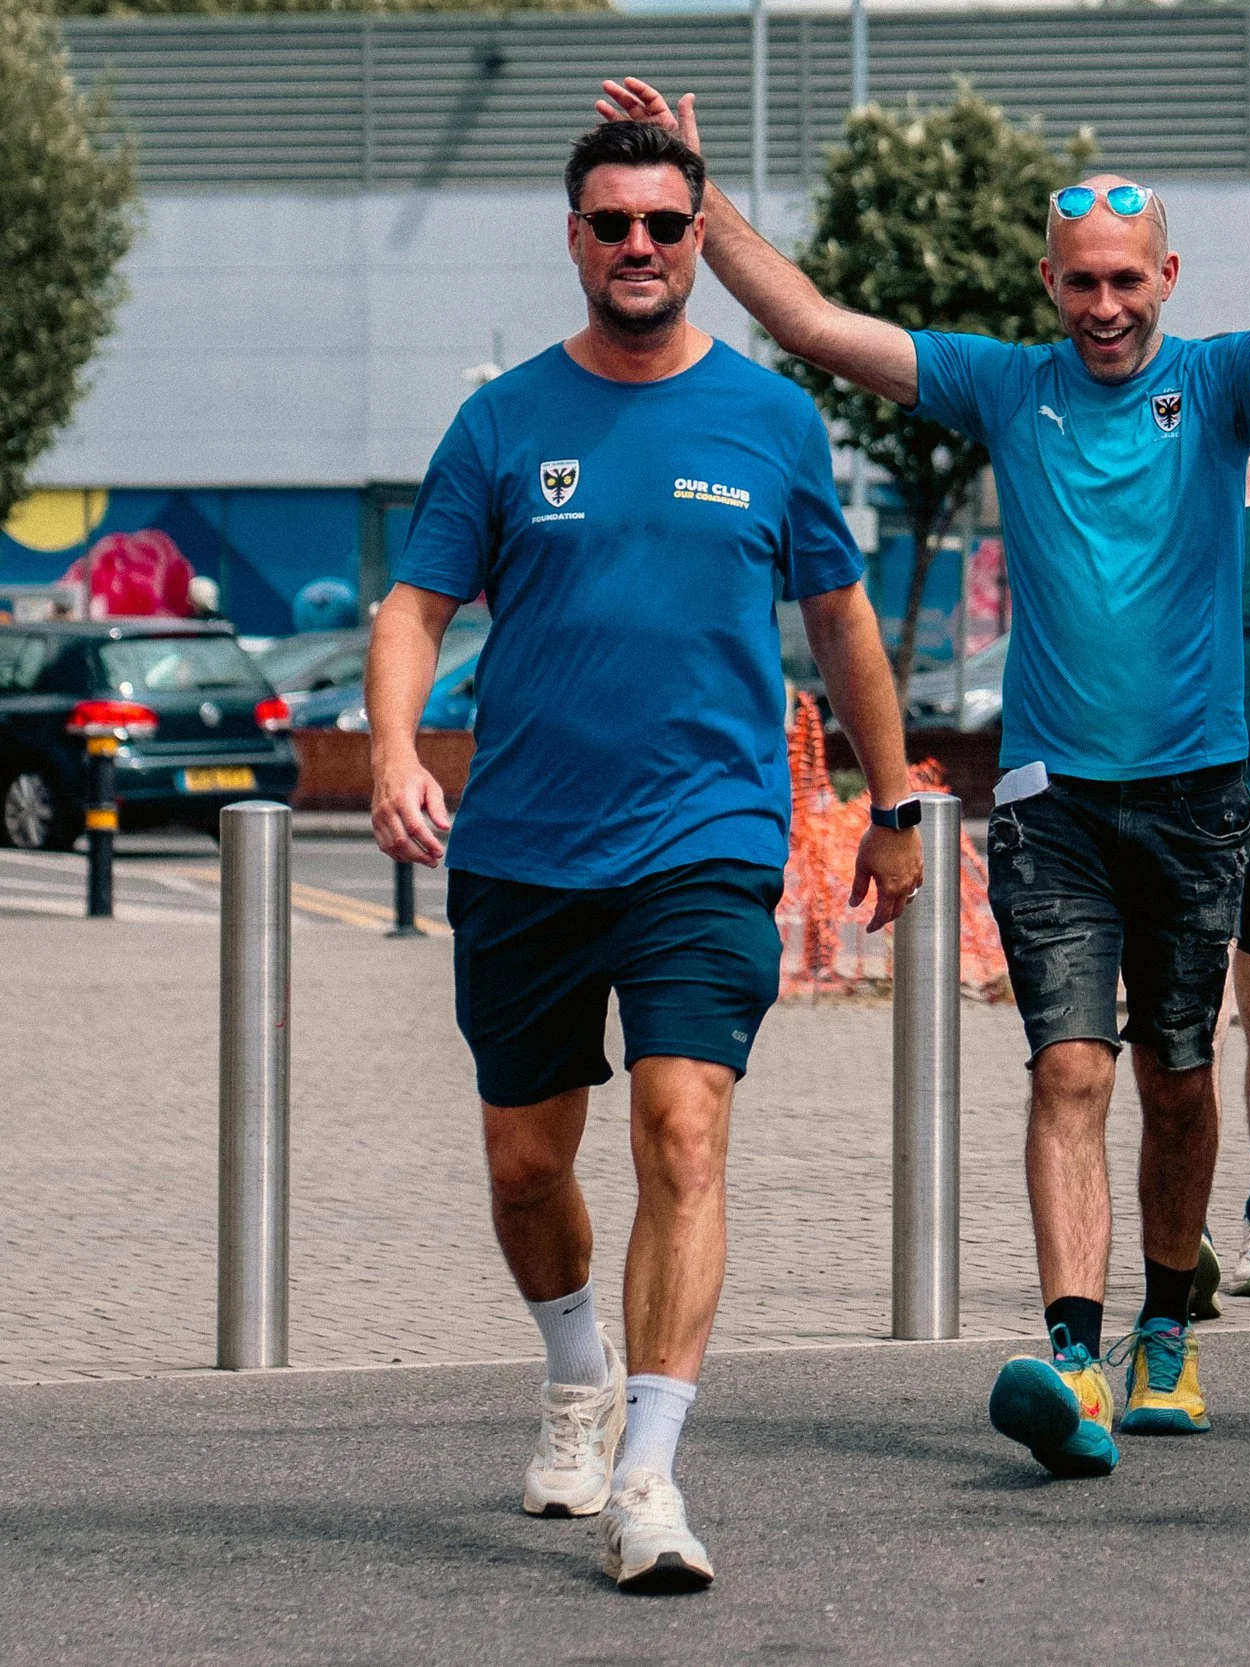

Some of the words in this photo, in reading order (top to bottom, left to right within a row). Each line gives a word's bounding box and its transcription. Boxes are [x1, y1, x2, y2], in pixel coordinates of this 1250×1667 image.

[673, 490, 695, 499] OUR
[695, 492, 750, 510] COMMUNITY
[674, 478, 709, 492] OUR
[712, 483, 750, 502] CLUB
[531, 512, 585, 524] FOUNDATION
